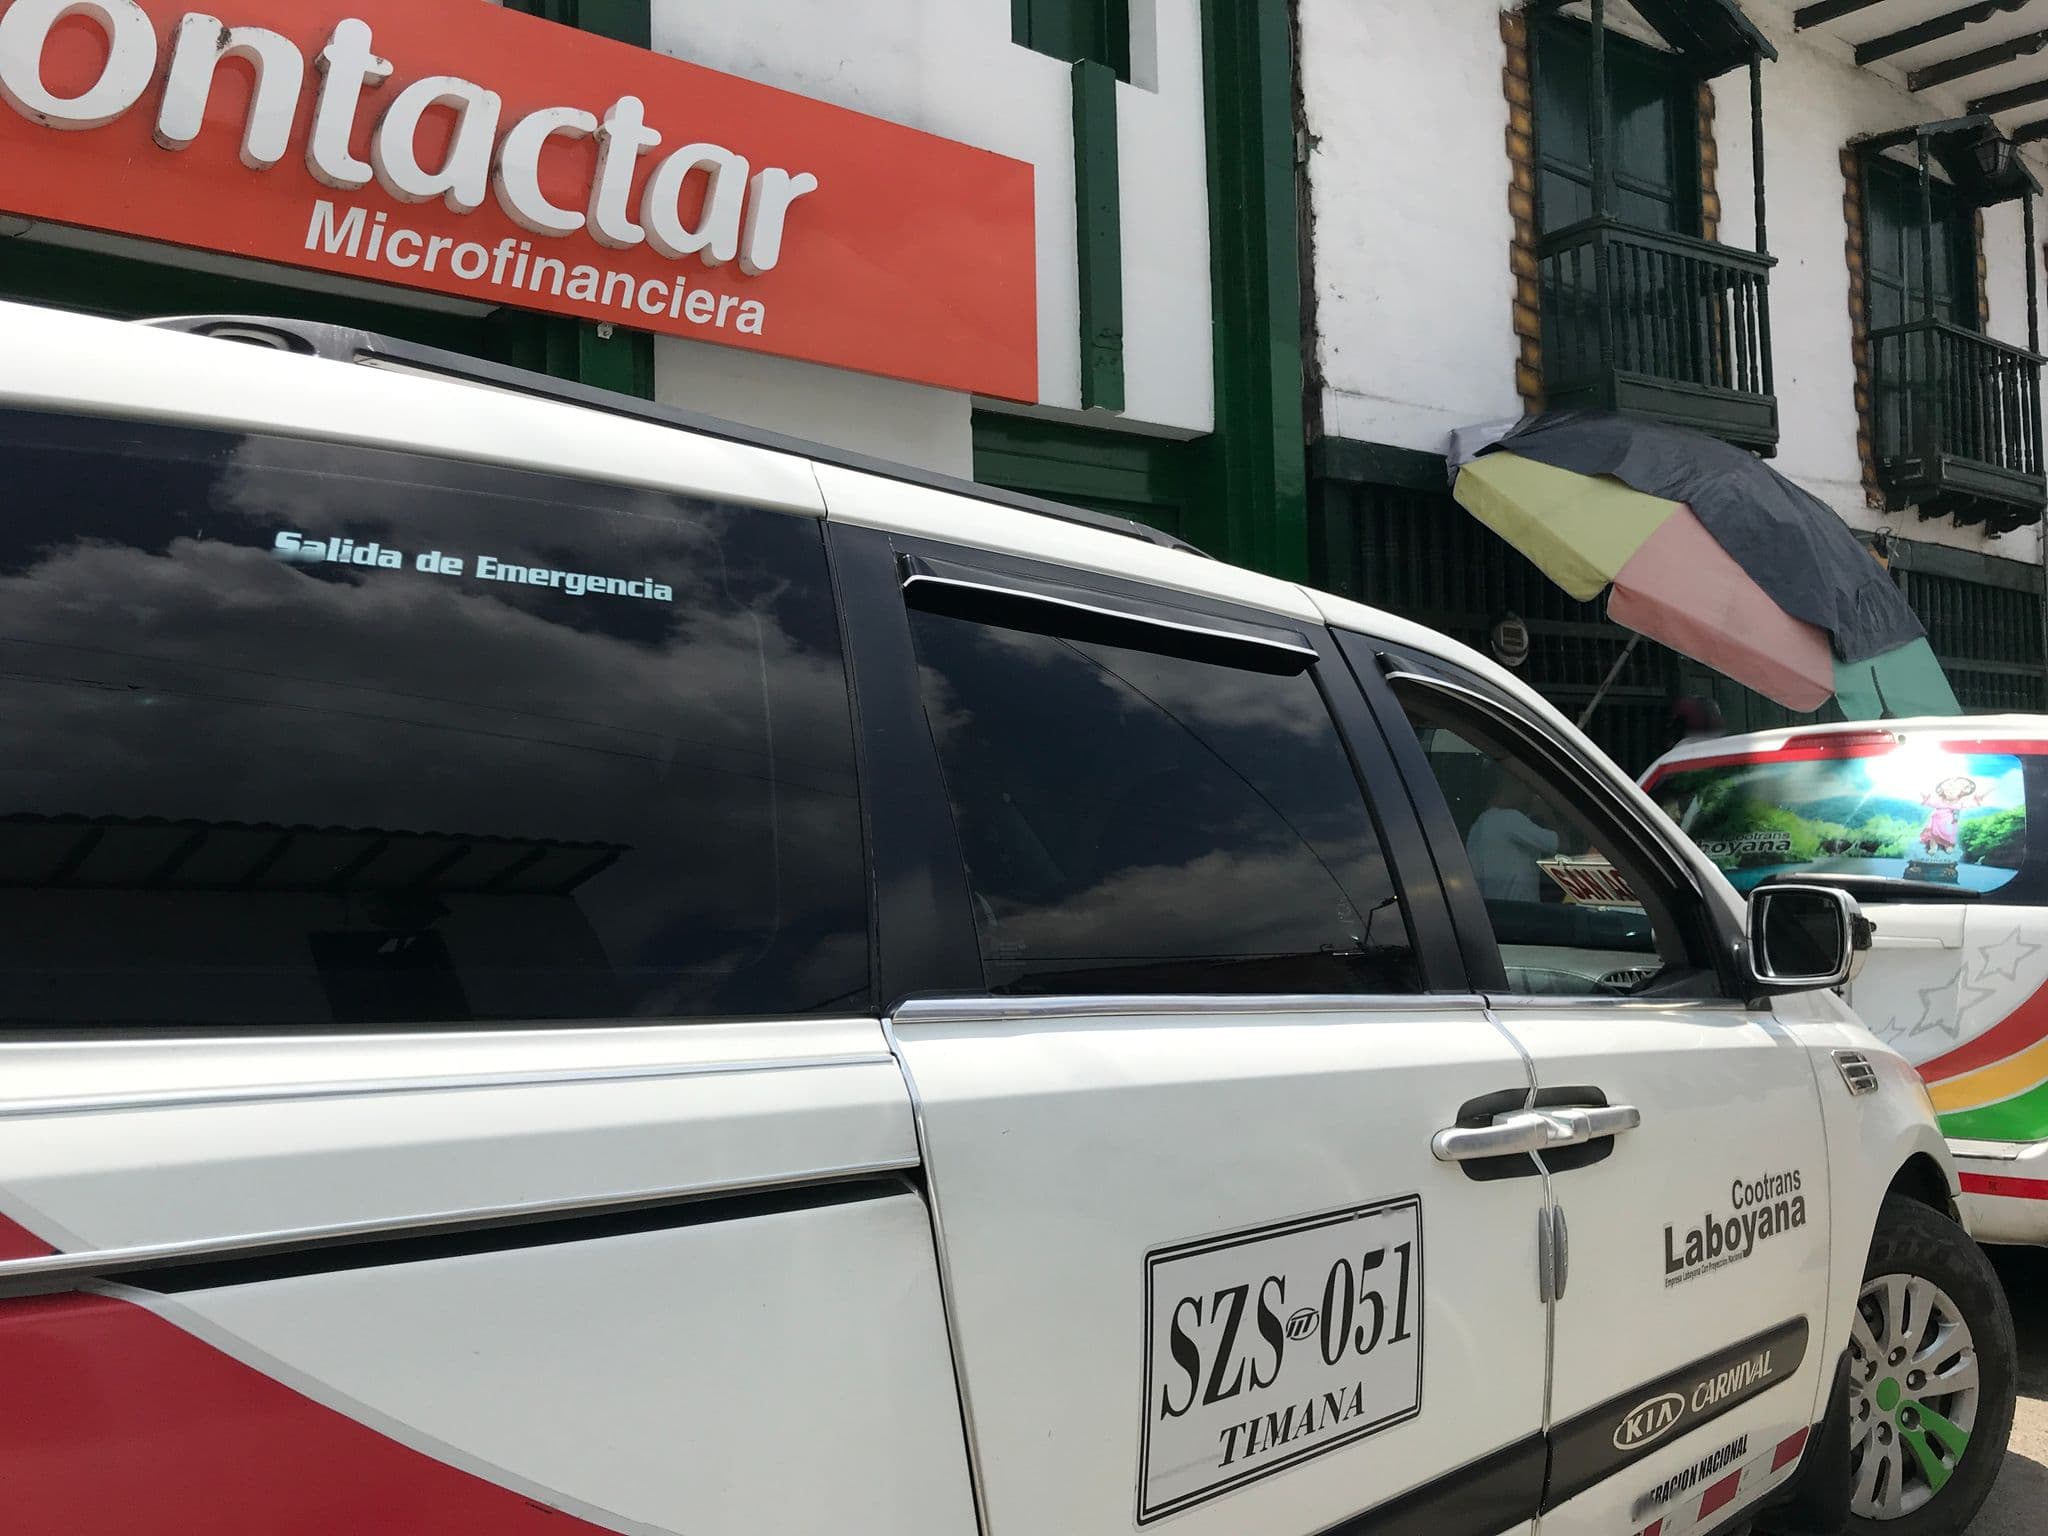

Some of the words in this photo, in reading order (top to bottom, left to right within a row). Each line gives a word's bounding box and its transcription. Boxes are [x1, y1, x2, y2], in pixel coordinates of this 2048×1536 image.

[304, 200, 768, 336] Microfinanciera
[273, 530, 403, 570] Salida
[415, 550, 464, 577] de
[475, 555, 673, 603] Emergencia
[1731, 1169, 1801, 1210] Cootrans
[1664, 1195, 1806, 1275] Laboyana
[1160, 1274, 1286, 1421] SZS
[1320, 1240, 1412, 1366] 051
[1218, 1380, 1365, 1469] TIMANA
[1625, 1403, 1673, 1444] KIA
[1691, 1350, 1773, 1413] CARNIVAL
[1698, 1433, 1748, 1482] NACIONAL
